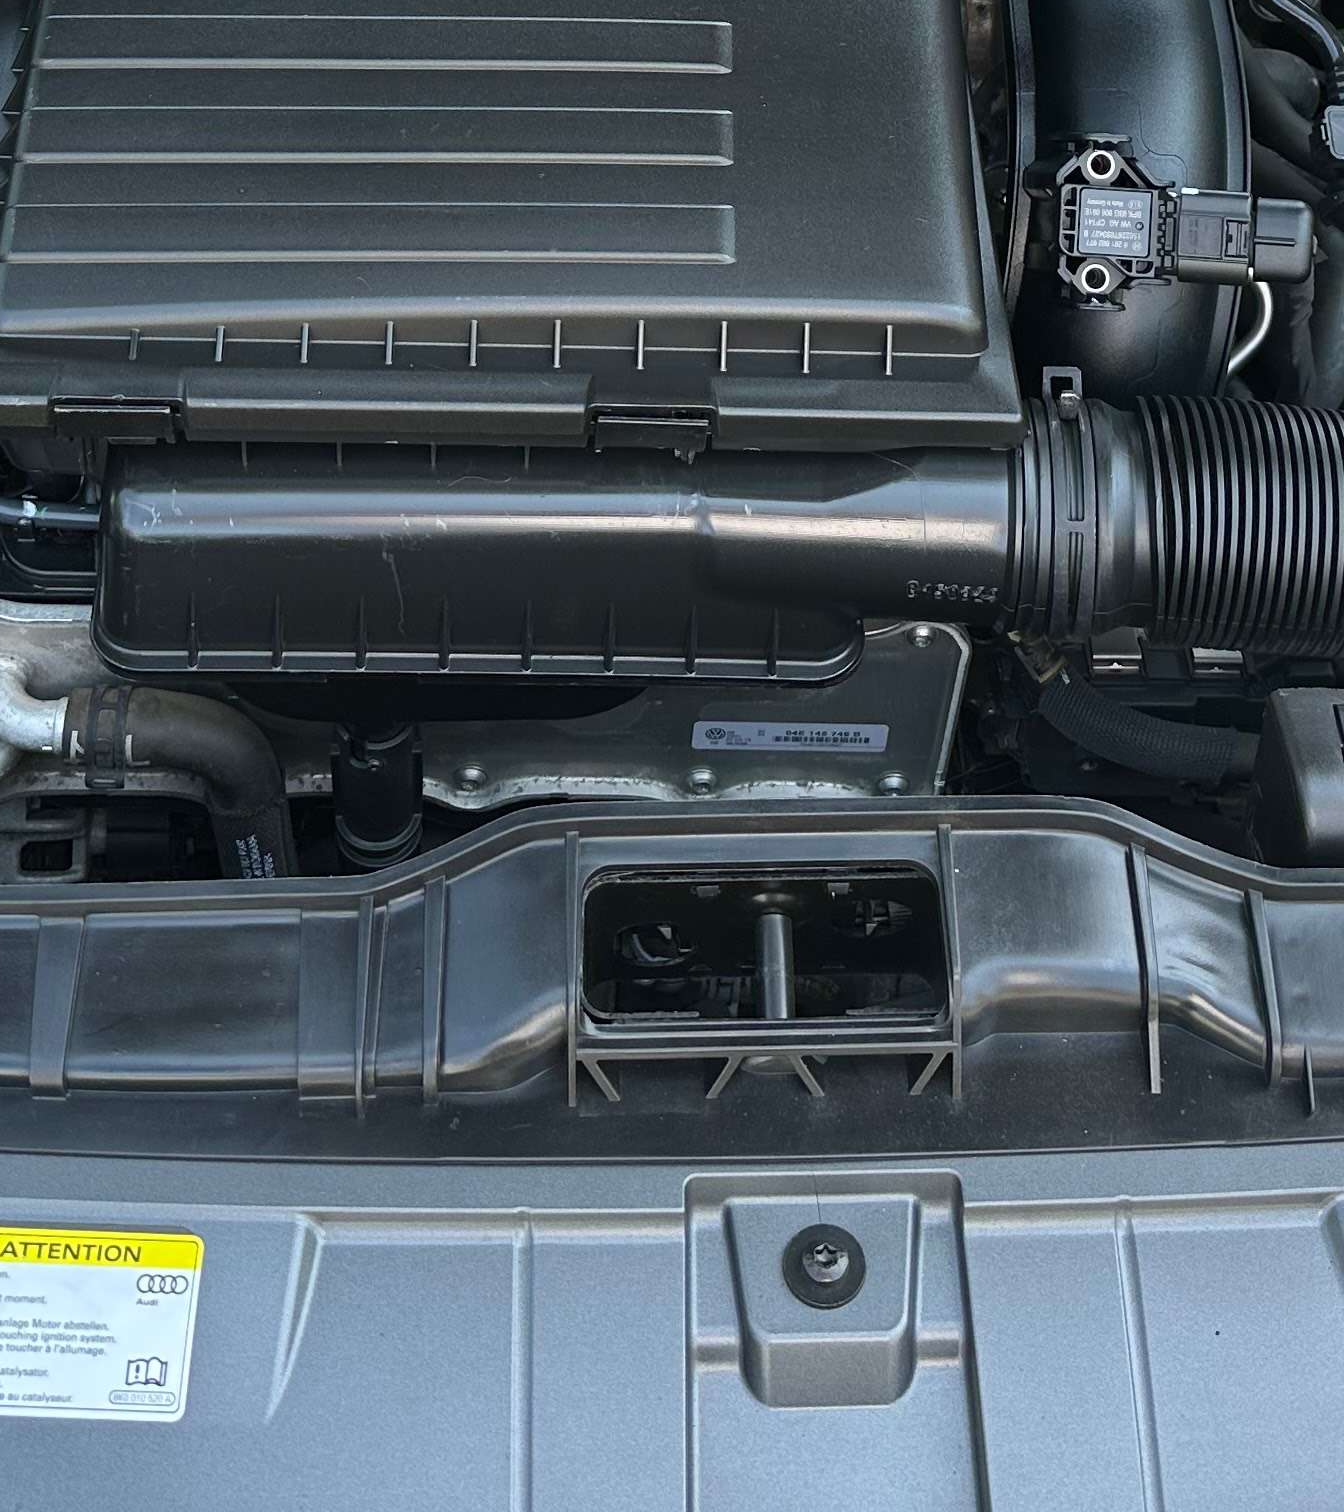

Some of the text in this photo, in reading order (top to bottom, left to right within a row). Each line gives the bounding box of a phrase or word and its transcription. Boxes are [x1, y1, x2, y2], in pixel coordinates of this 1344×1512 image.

[0, 1240, 141, 1262] ATTENTION
[3, 1295, 47, 1304] moment.
[135, 1298, 158, 1306] Audi
[31, 1319, 61, 1328] Motor
[63, 1320, 109, 1330] abstellen.
[40, 1332, 77, 1343] ignition
[79, 1334, 117, 1343] system.
[5, 1343, 43, 1352] toucher
[44, 1345, 51, 1353] à
[52, 1344, 107, 1356] l'allumage.
